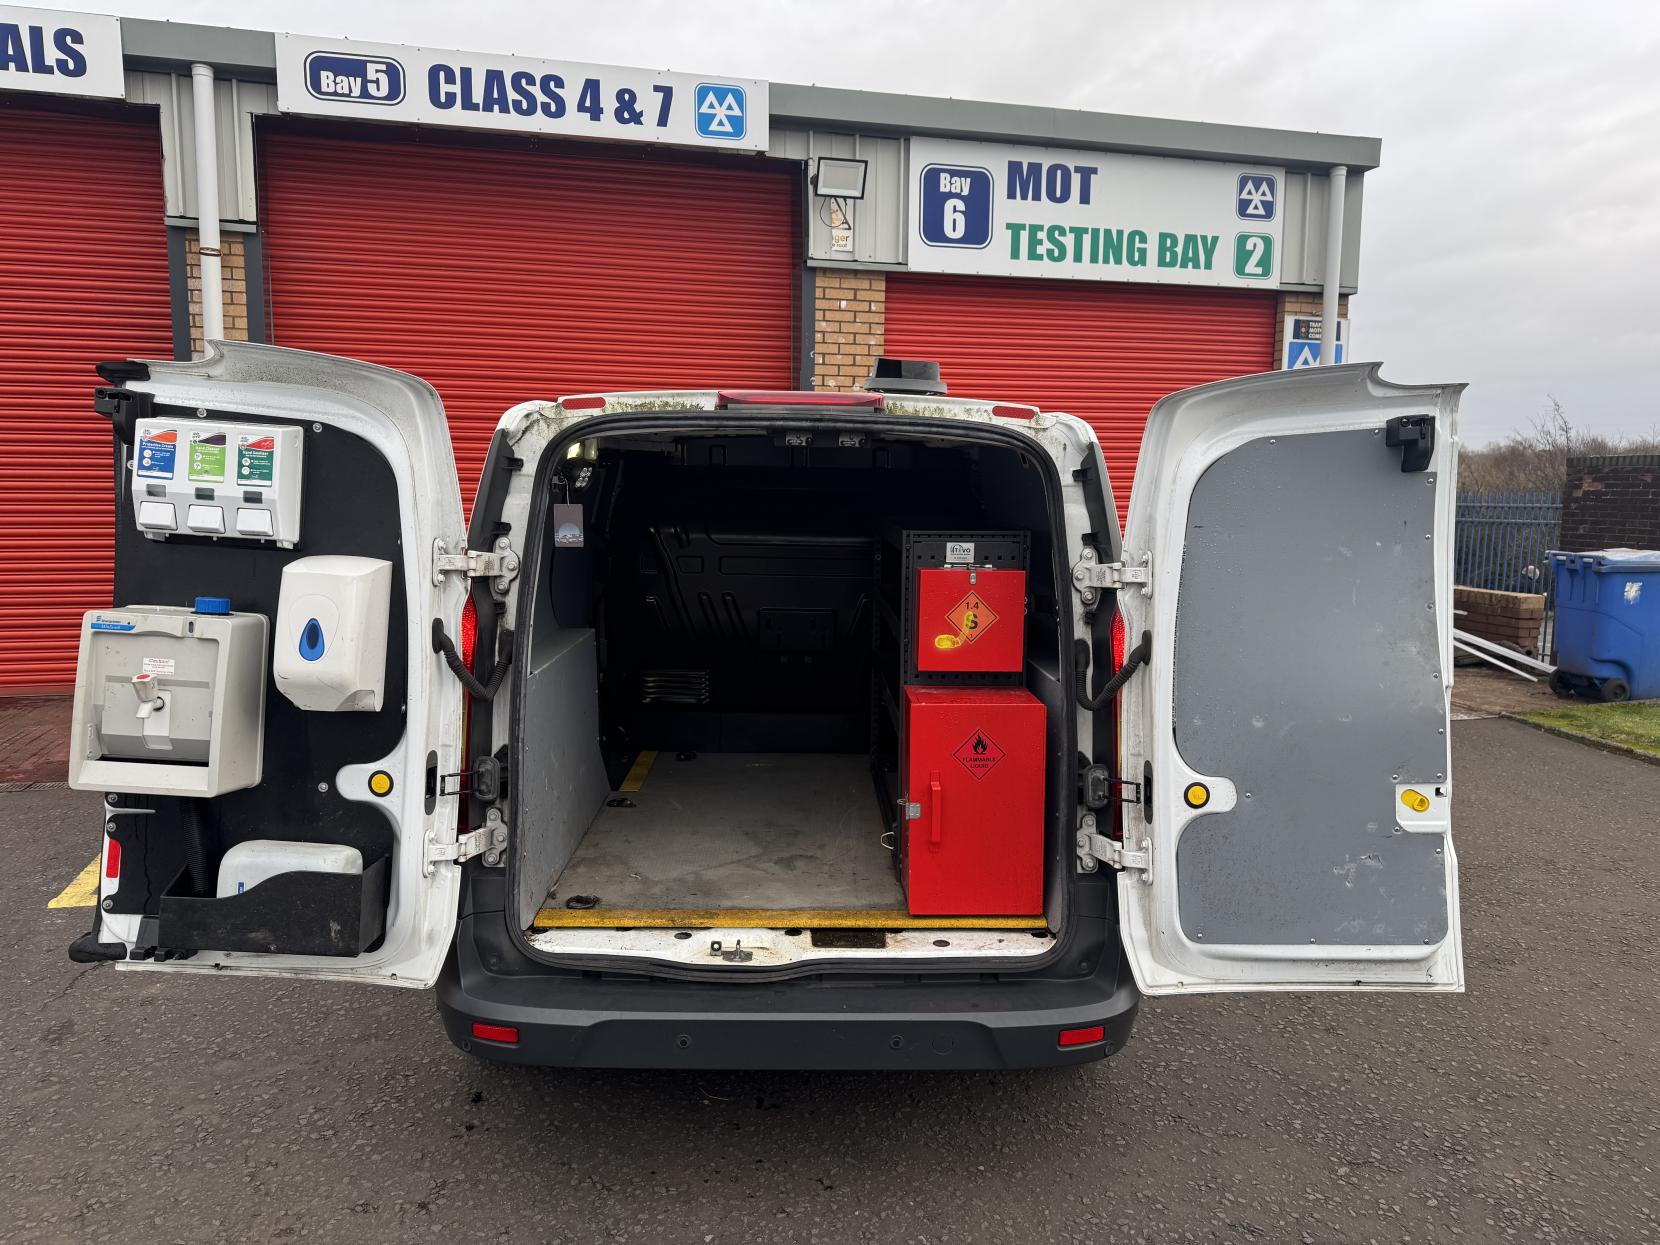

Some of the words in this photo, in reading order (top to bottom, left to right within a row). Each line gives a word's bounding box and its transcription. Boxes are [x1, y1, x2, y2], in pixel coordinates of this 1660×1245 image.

[0, 23, 88, 78] ALS
[320, 71, 362, 98] Bay
[366, 62, 389, 98] 5
[428, 63, 567, 119] CLASS
[576, 79, 604, 122] 4
[613, 87, 644, 126] &
[652, 84, 674, 128] 7
[939, 172, 971, 196] Bay
[1006, 159, 1099, 206] MOT
[943, 198, 966, 239] 6
[1005, 222, 1148, 267] TESTING
[1157, 231, 1220, 271] BAY
[1244, 236, 1265, 275] 2
[965, 601, 979, 610] 1.4
